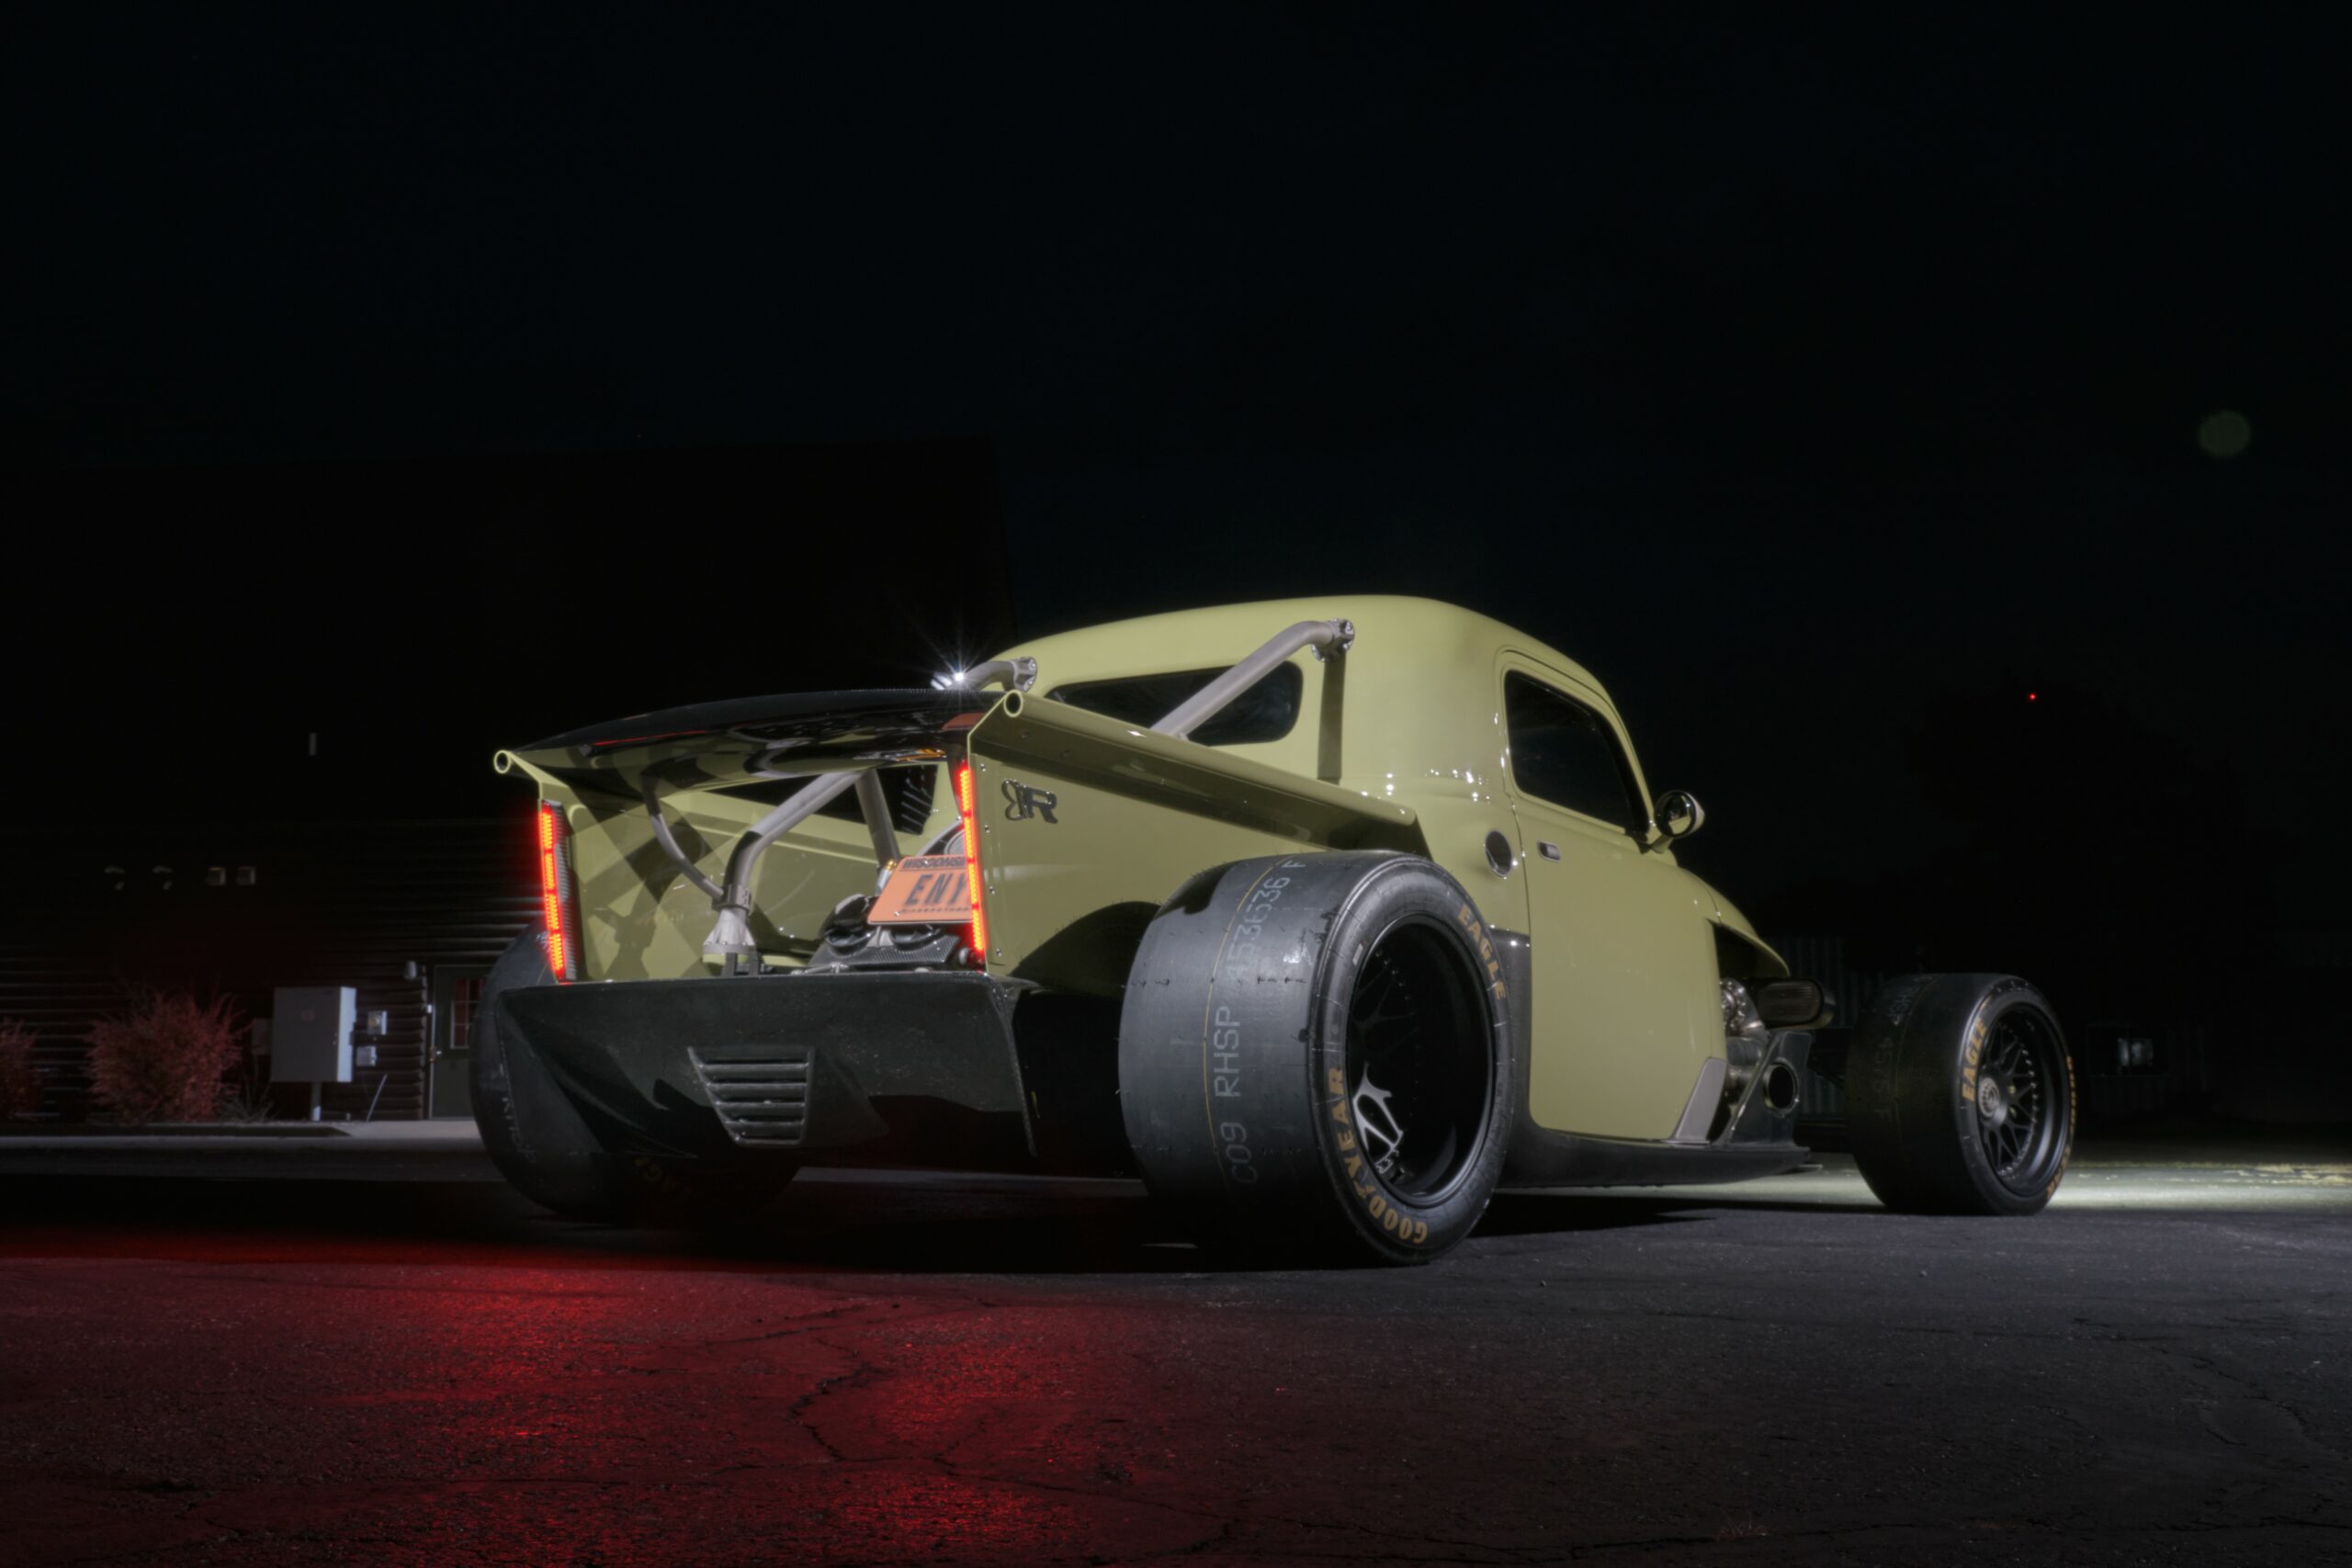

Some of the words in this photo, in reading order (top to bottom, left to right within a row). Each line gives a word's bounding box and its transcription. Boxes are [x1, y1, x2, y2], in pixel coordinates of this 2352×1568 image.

[902, 855, 966, 869] WISCONSI
[905, 874, 967, 906] ENY
[1457, 903, 1506, 1000] EAGLE
[1213, 1006, 1240, 1097] RHSP
[1961, 1017, 1985, 1102] EAGLE
[1329, 1067, 1429, 1245] GOODYEAR
